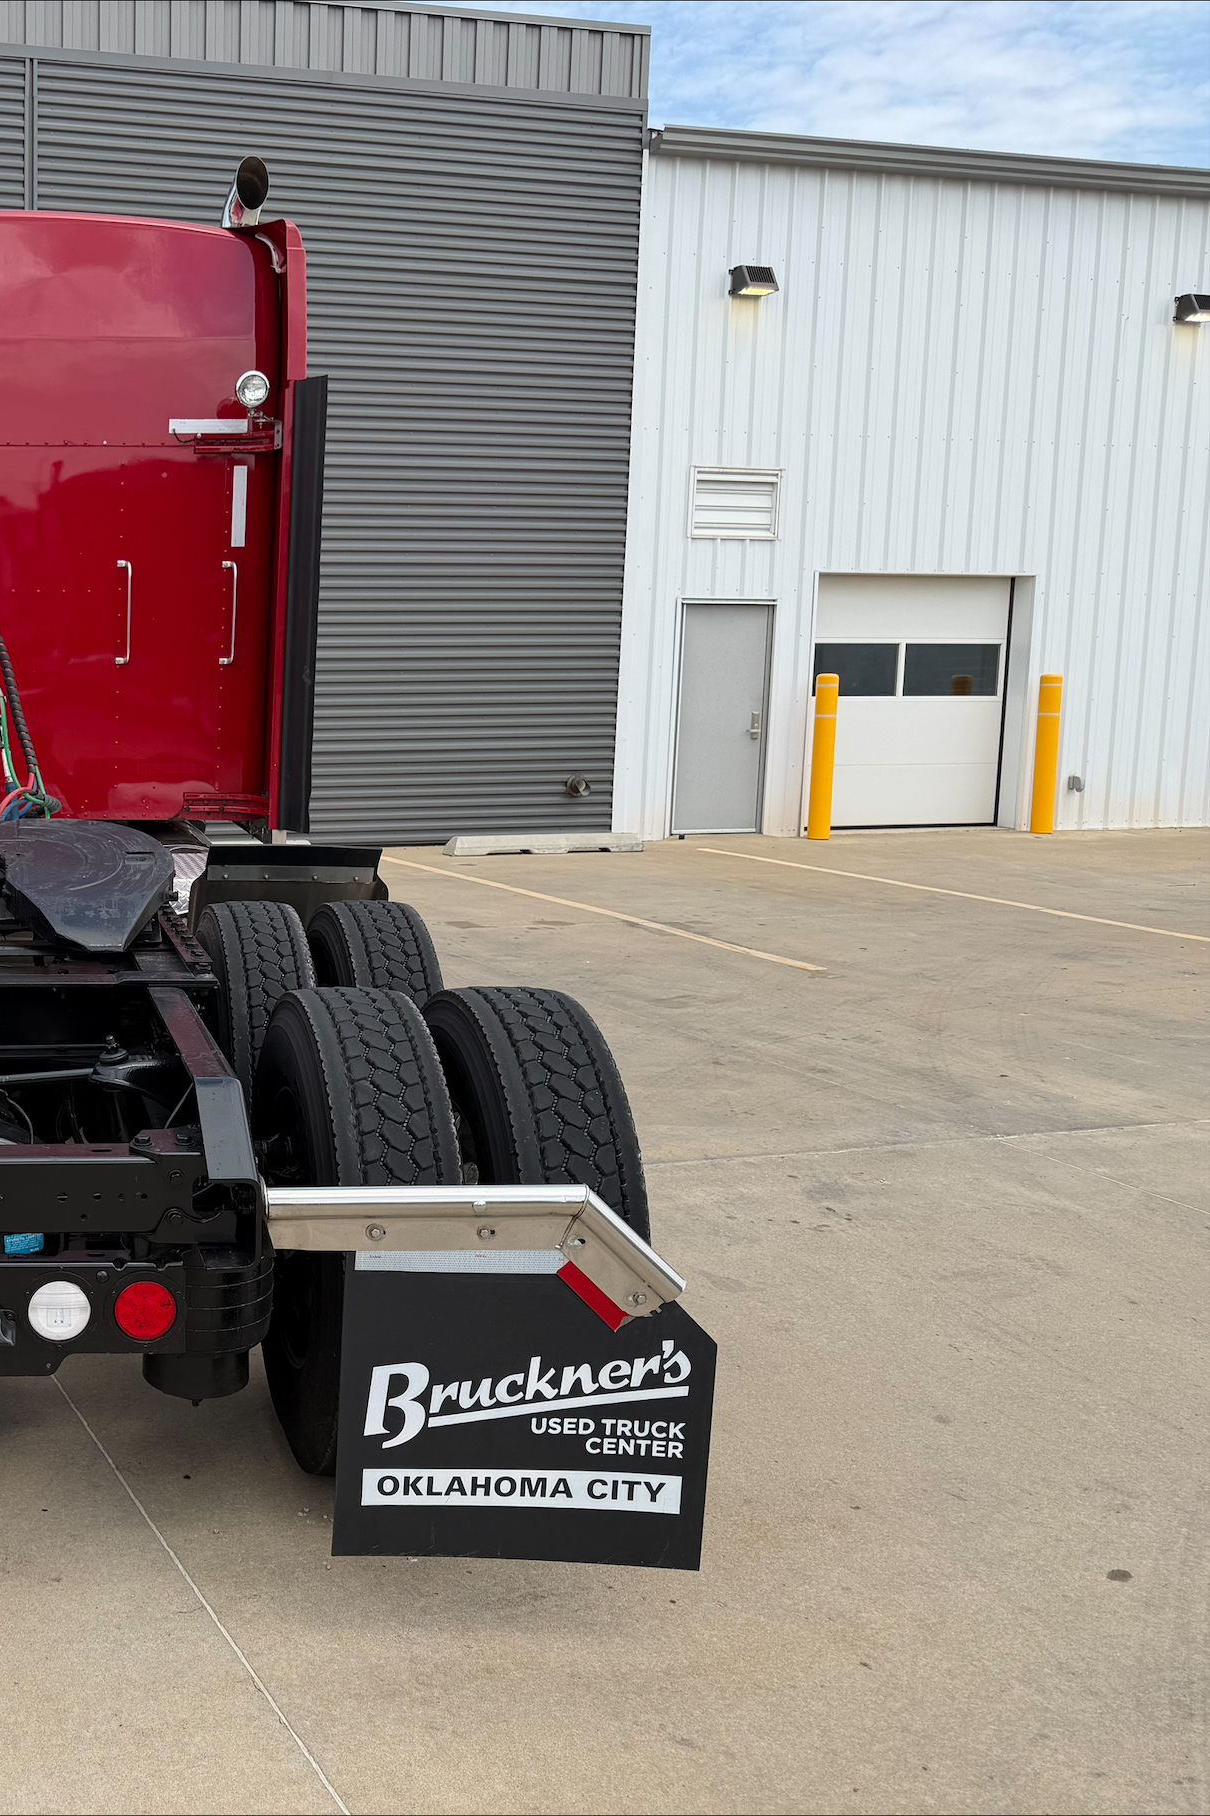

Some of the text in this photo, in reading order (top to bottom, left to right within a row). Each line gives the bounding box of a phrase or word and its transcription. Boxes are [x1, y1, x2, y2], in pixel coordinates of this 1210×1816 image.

[364, 1340, 692, 1449] Bruckner's
[530, 1418, 686, 1439] USED TRUCK
[585, 1436, 684, 1459] CENTER
[377, 1475, 666, 1502] OKLAHOMA CITY
